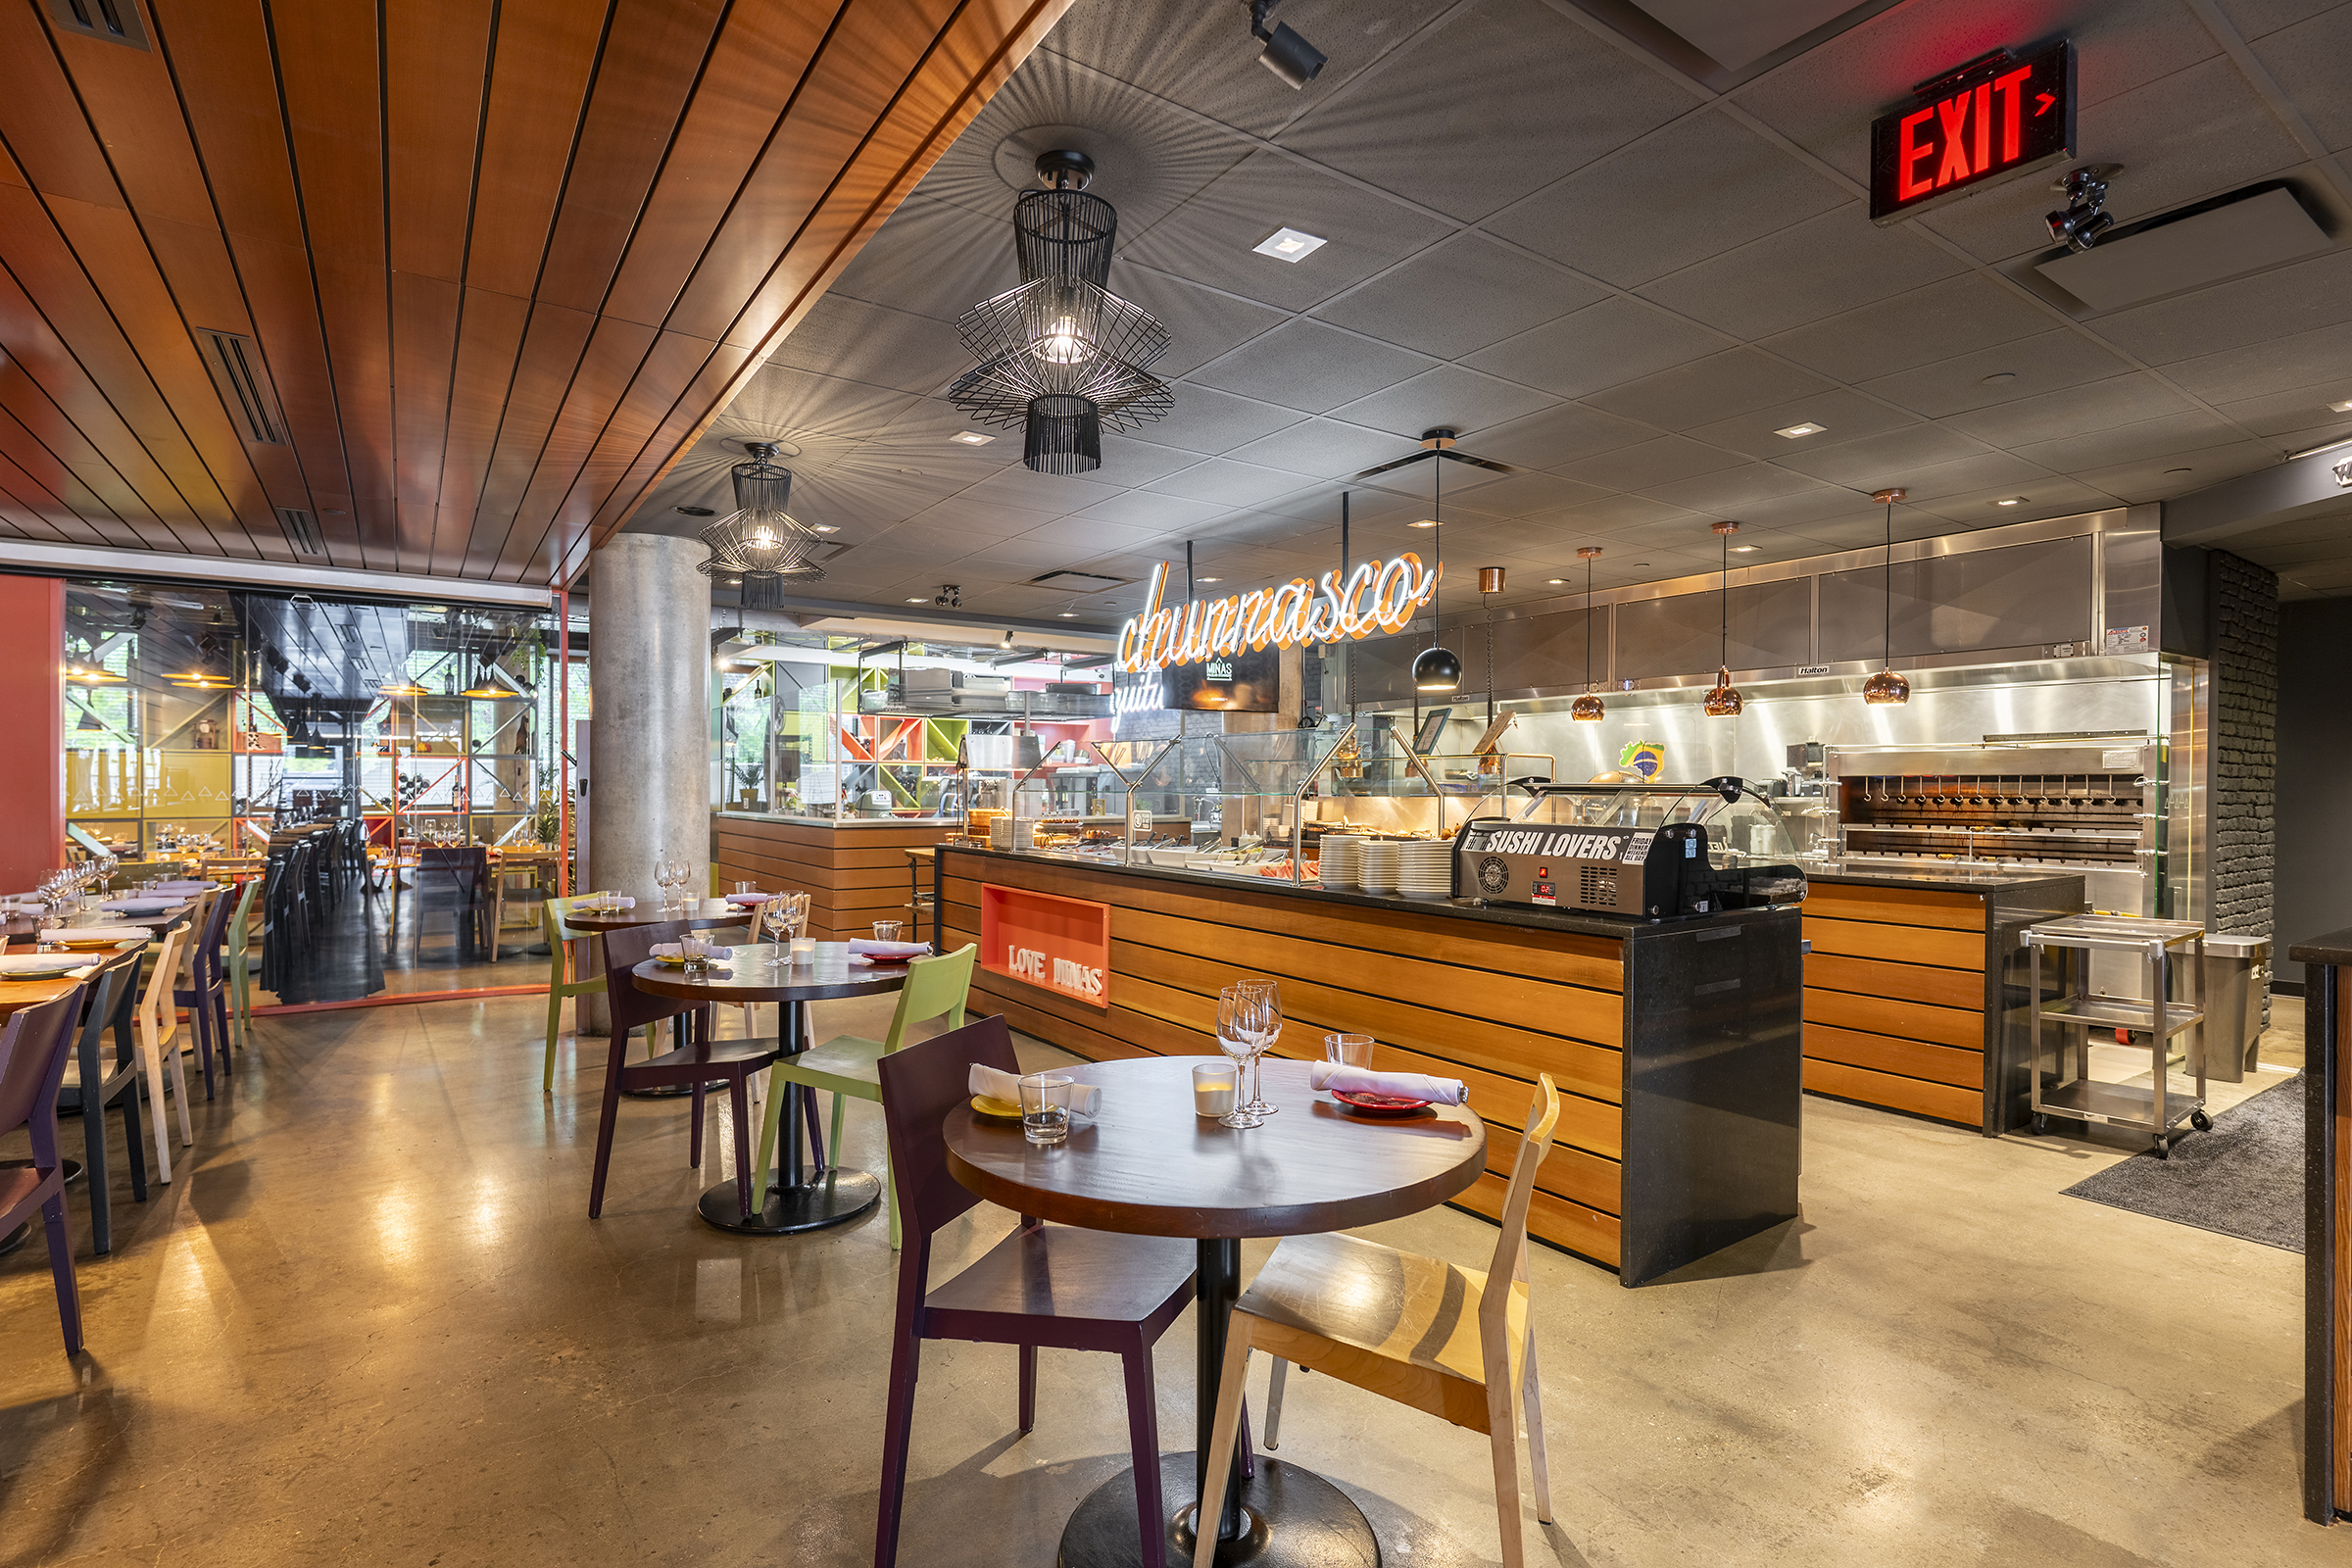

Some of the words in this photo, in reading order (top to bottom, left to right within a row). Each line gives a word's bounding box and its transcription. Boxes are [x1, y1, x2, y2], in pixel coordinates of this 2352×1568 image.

[1898, 65, 2032, 201] EXIT
[1206, 662, 1233, 674] MINAS
[1485, 830, 1544, 856] SUSHI
[1541, 833, 1622, 860] LOVERS
[1008, 945, 1046, 979] LOVE
[1053, 957, 1102, 996] MINAS
